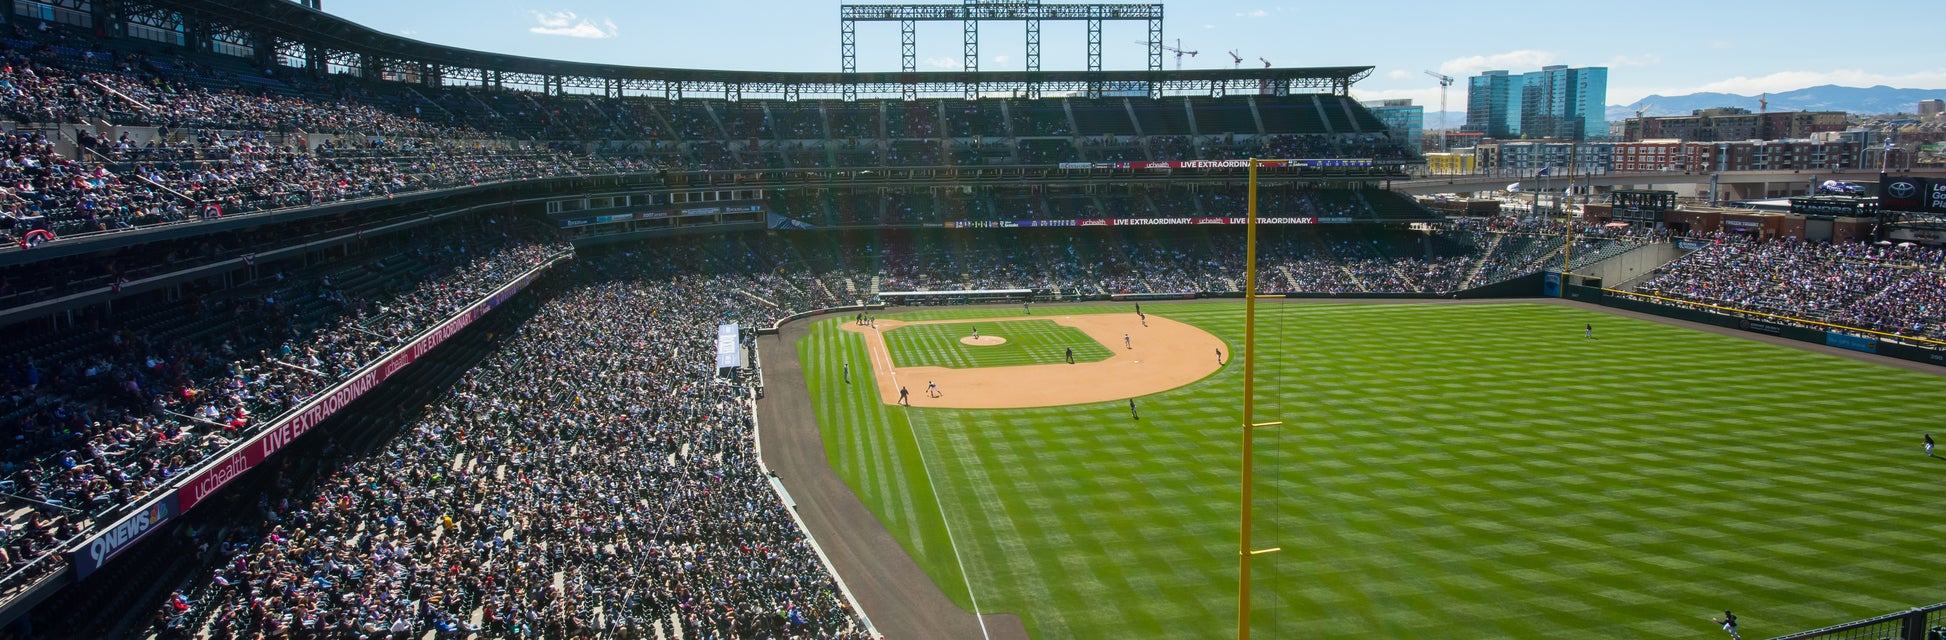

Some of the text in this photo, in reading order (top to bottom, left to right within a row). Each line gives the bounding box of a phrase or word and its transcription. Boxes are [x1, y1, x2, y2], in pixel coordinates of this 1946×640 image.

[1198, 160, 1265, 168] EXTRAORDINY.
[1826, 185, 1844, 193] TOYOTA
[1932, 191, 1946, 200] Go
[1113, 217, 1193, 226] LIVE EXTRAORDINARY.
[413, 312, 472, 359] LIVE EXTRAORDINARY.
[263, 369, 379, 458] LIVE EXTRAORDINARY.
[195, 451, 247, 502] uchealth
[90, 509, 150, 569] 9NEWS
